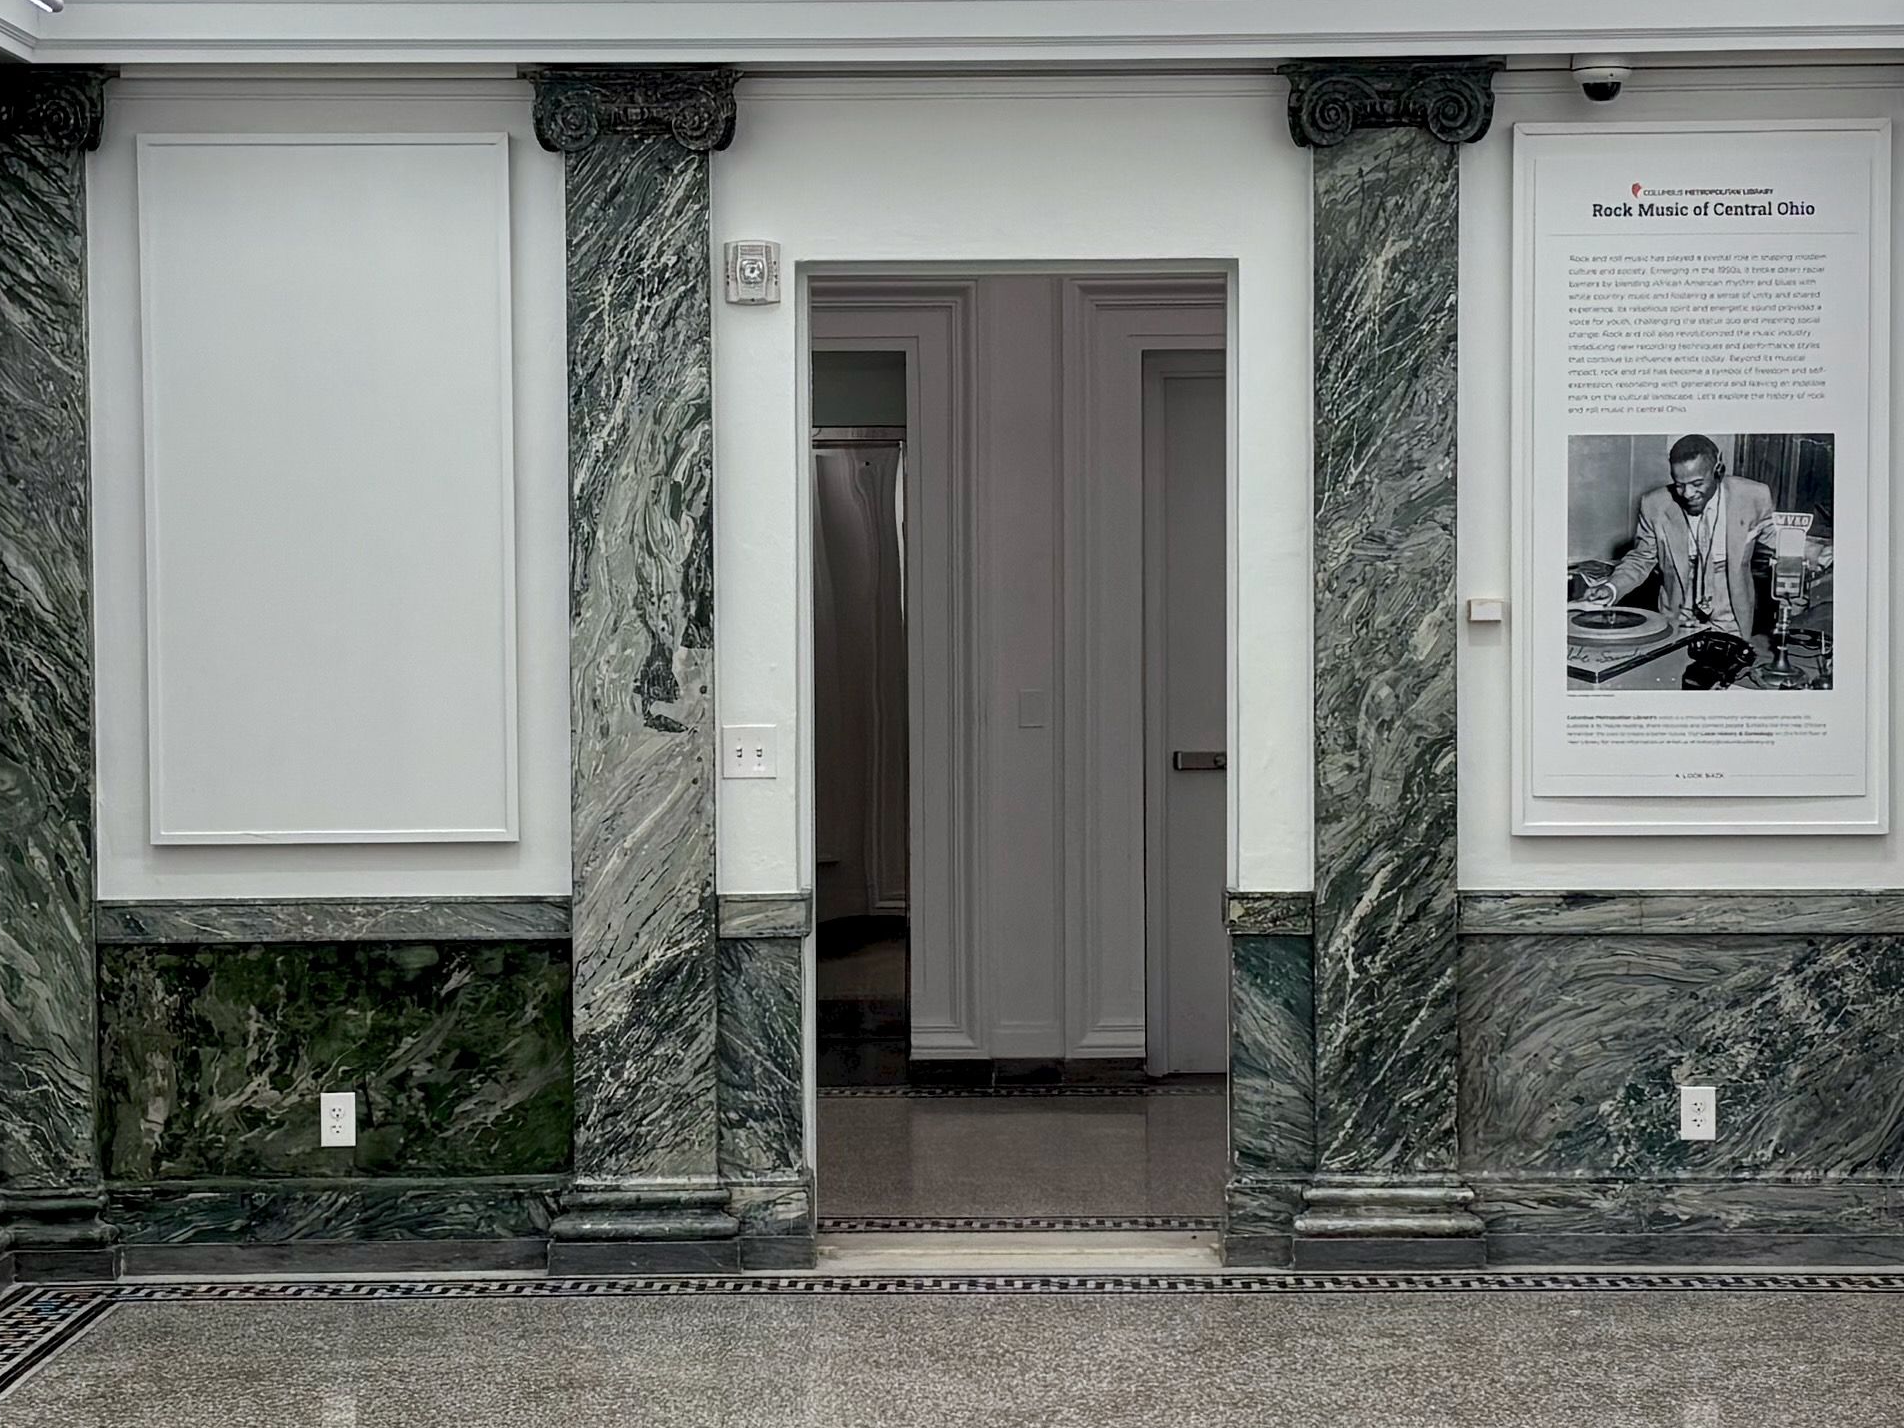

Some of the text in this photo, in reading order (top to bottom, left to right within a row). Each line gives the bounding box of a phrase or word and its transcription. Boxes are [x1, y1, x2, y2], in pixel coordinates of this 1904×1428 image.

[1592, 201, 1815, 218] Rock Music of Central Ohio
[1650, 267, 1689, 276] Emerging
